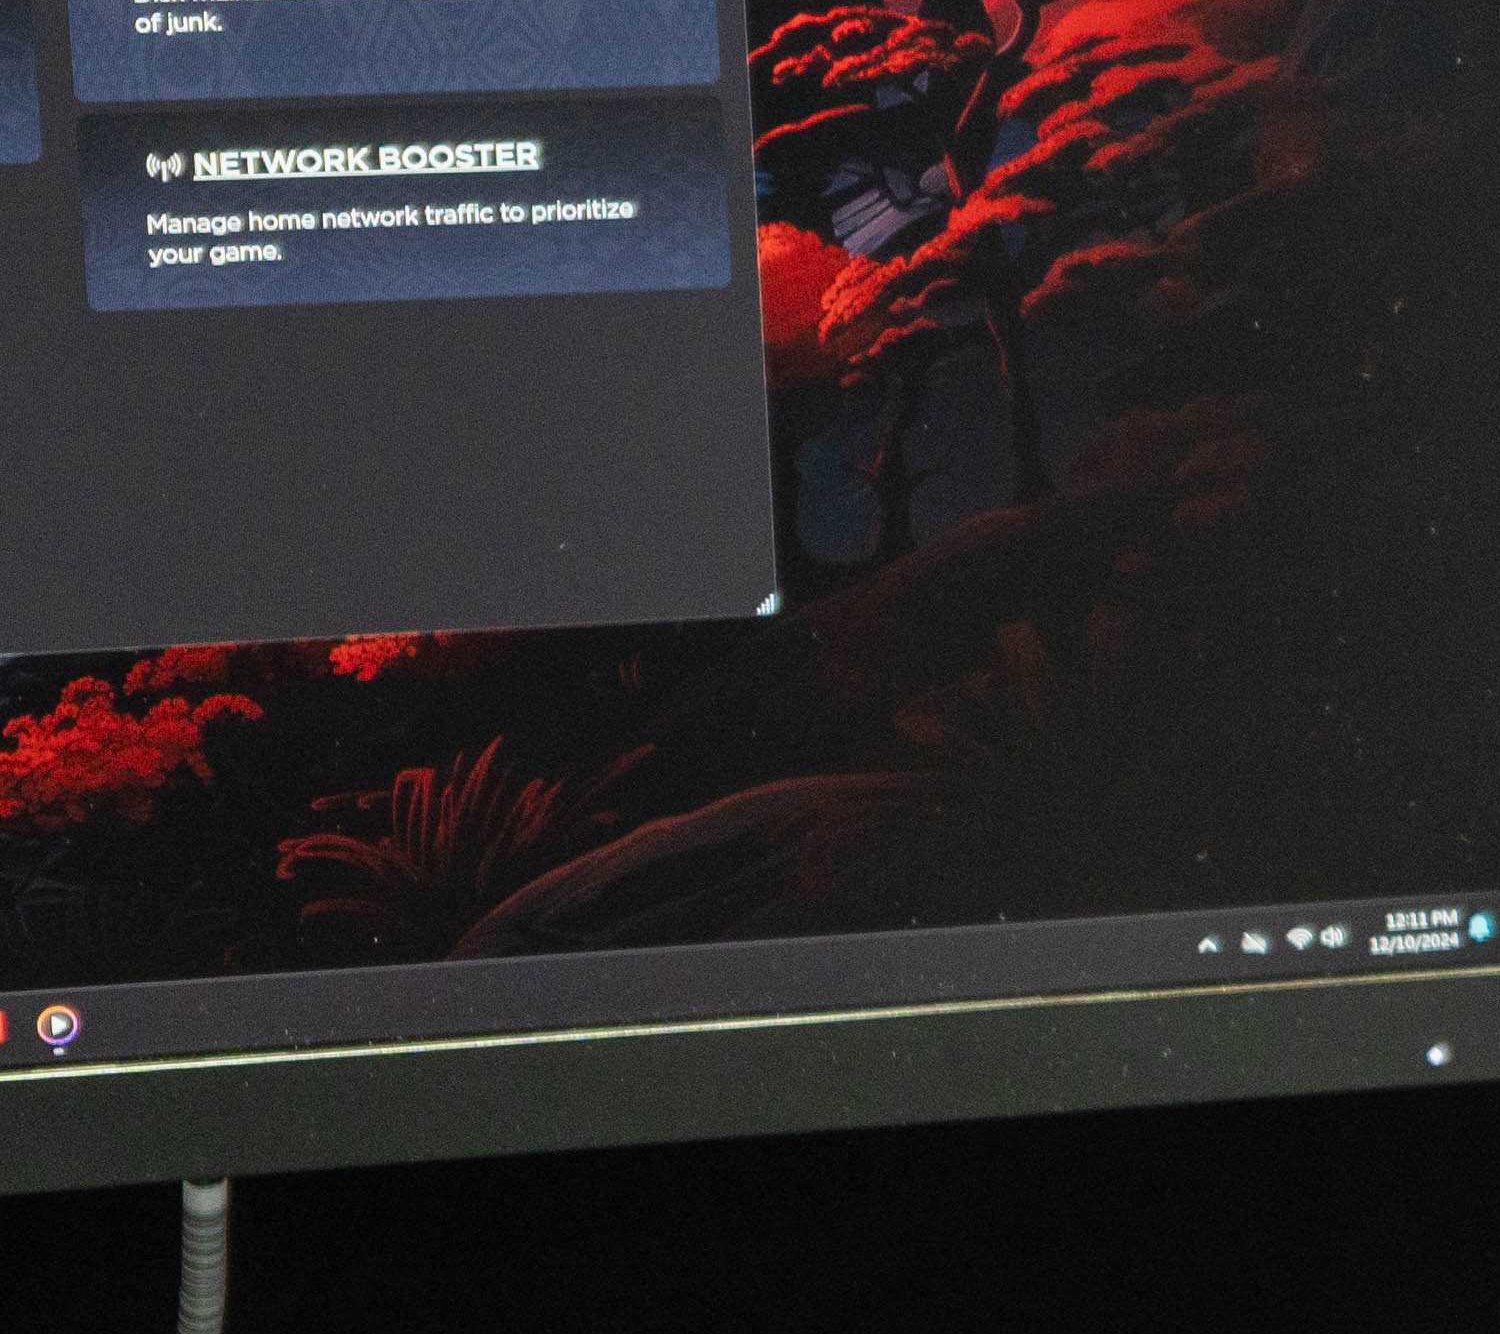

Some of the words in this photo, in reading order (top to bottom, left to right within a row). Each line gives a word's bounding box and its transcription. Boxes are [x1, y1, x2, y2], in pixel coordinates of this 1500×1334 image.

[135, 13, 162, 33] of
[166, 11, 223, 35] junk.
[194, 147, 370, 178] NETWORK
[379, 141, 539, 172] BOOSTER
[147, 214, 242, 235] Manage
[249, 210, 316, 231] home
[322, 205, 419, 229] network
[425, 202, 494, 225] traffic
[500, 202, 525, 223] to
[532, 199, 635, 225] prioritize
[148, 246, 204, 268] your
[210, 244, 283, 265] game.
[1386, 911, 1428, 931] 12:11
[1430, 909, 1459, 927] PM
[1369, 931, 1460, 955] 12/10/2024
